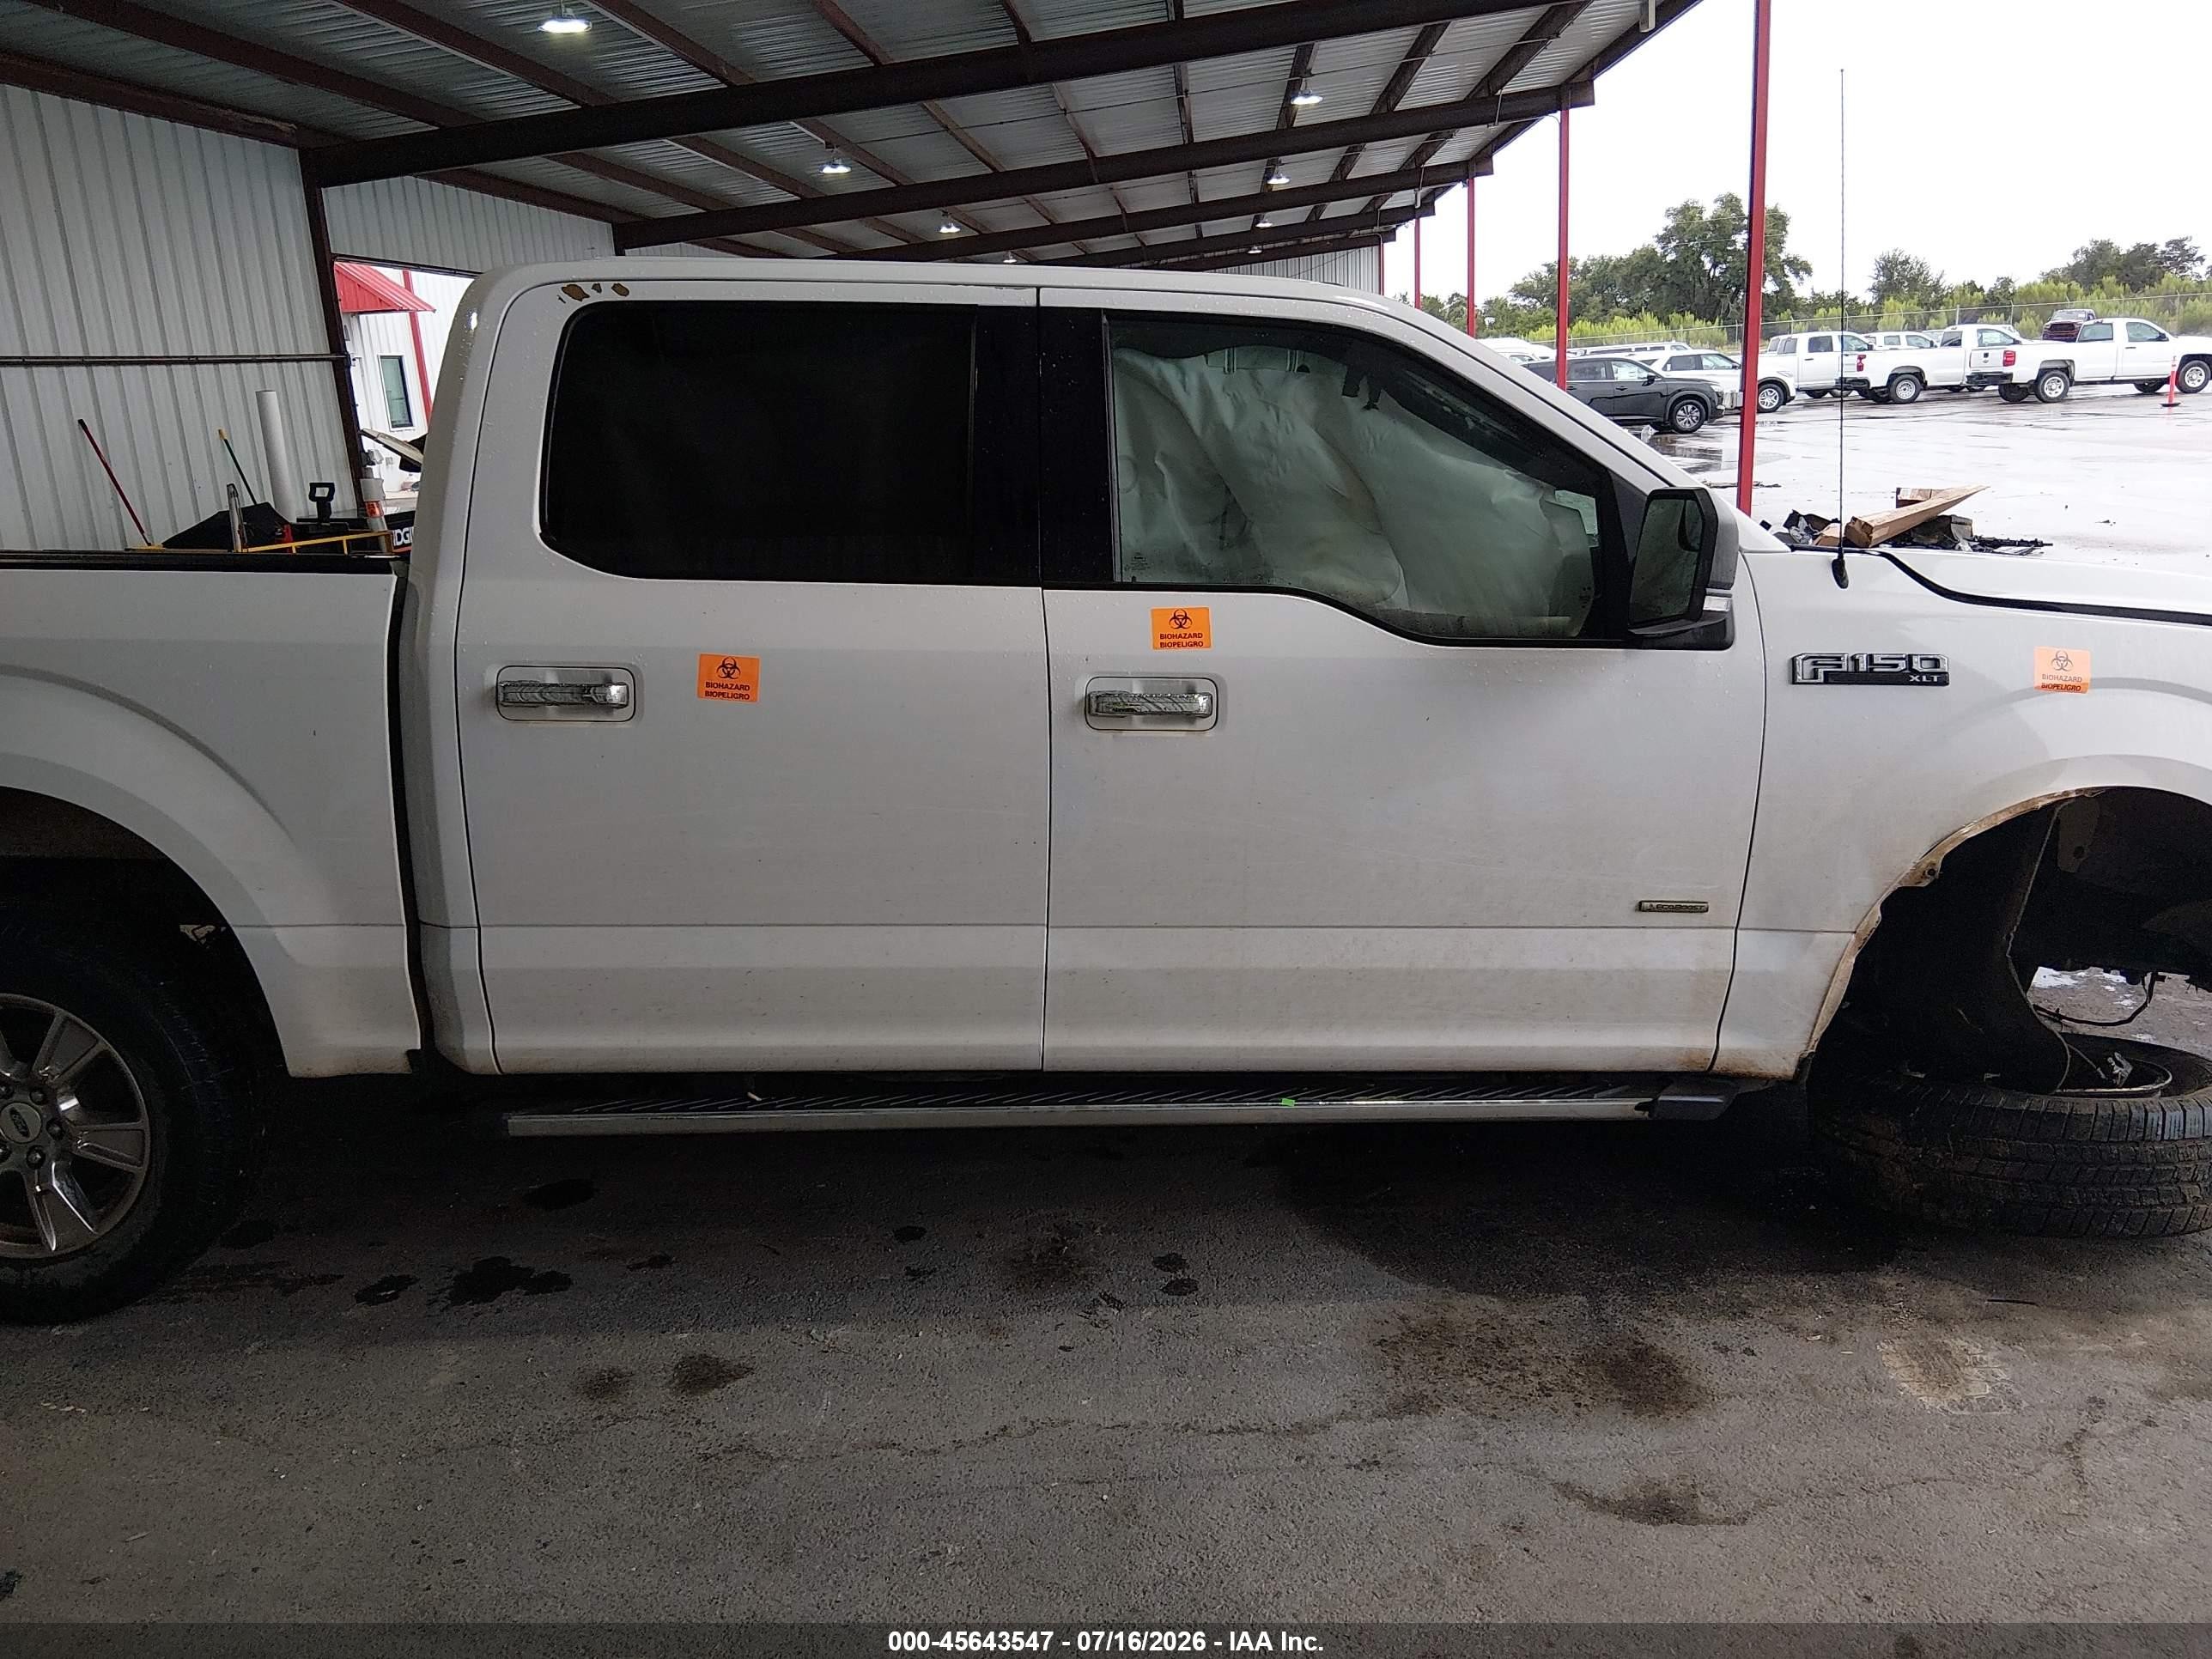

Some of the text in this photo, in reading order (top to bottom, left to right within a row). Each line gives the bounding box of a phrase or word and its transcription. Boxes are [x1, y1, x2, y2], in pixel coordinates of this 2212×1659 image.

[2042, 674, 2082, 683] BIOHAZARD
[705, 682, 750, 691] BIOHAZARD
[2041, 683, 2081, 691] BIOPELIGRO
[704, 690, 750, 700] BIOPELIGRO
